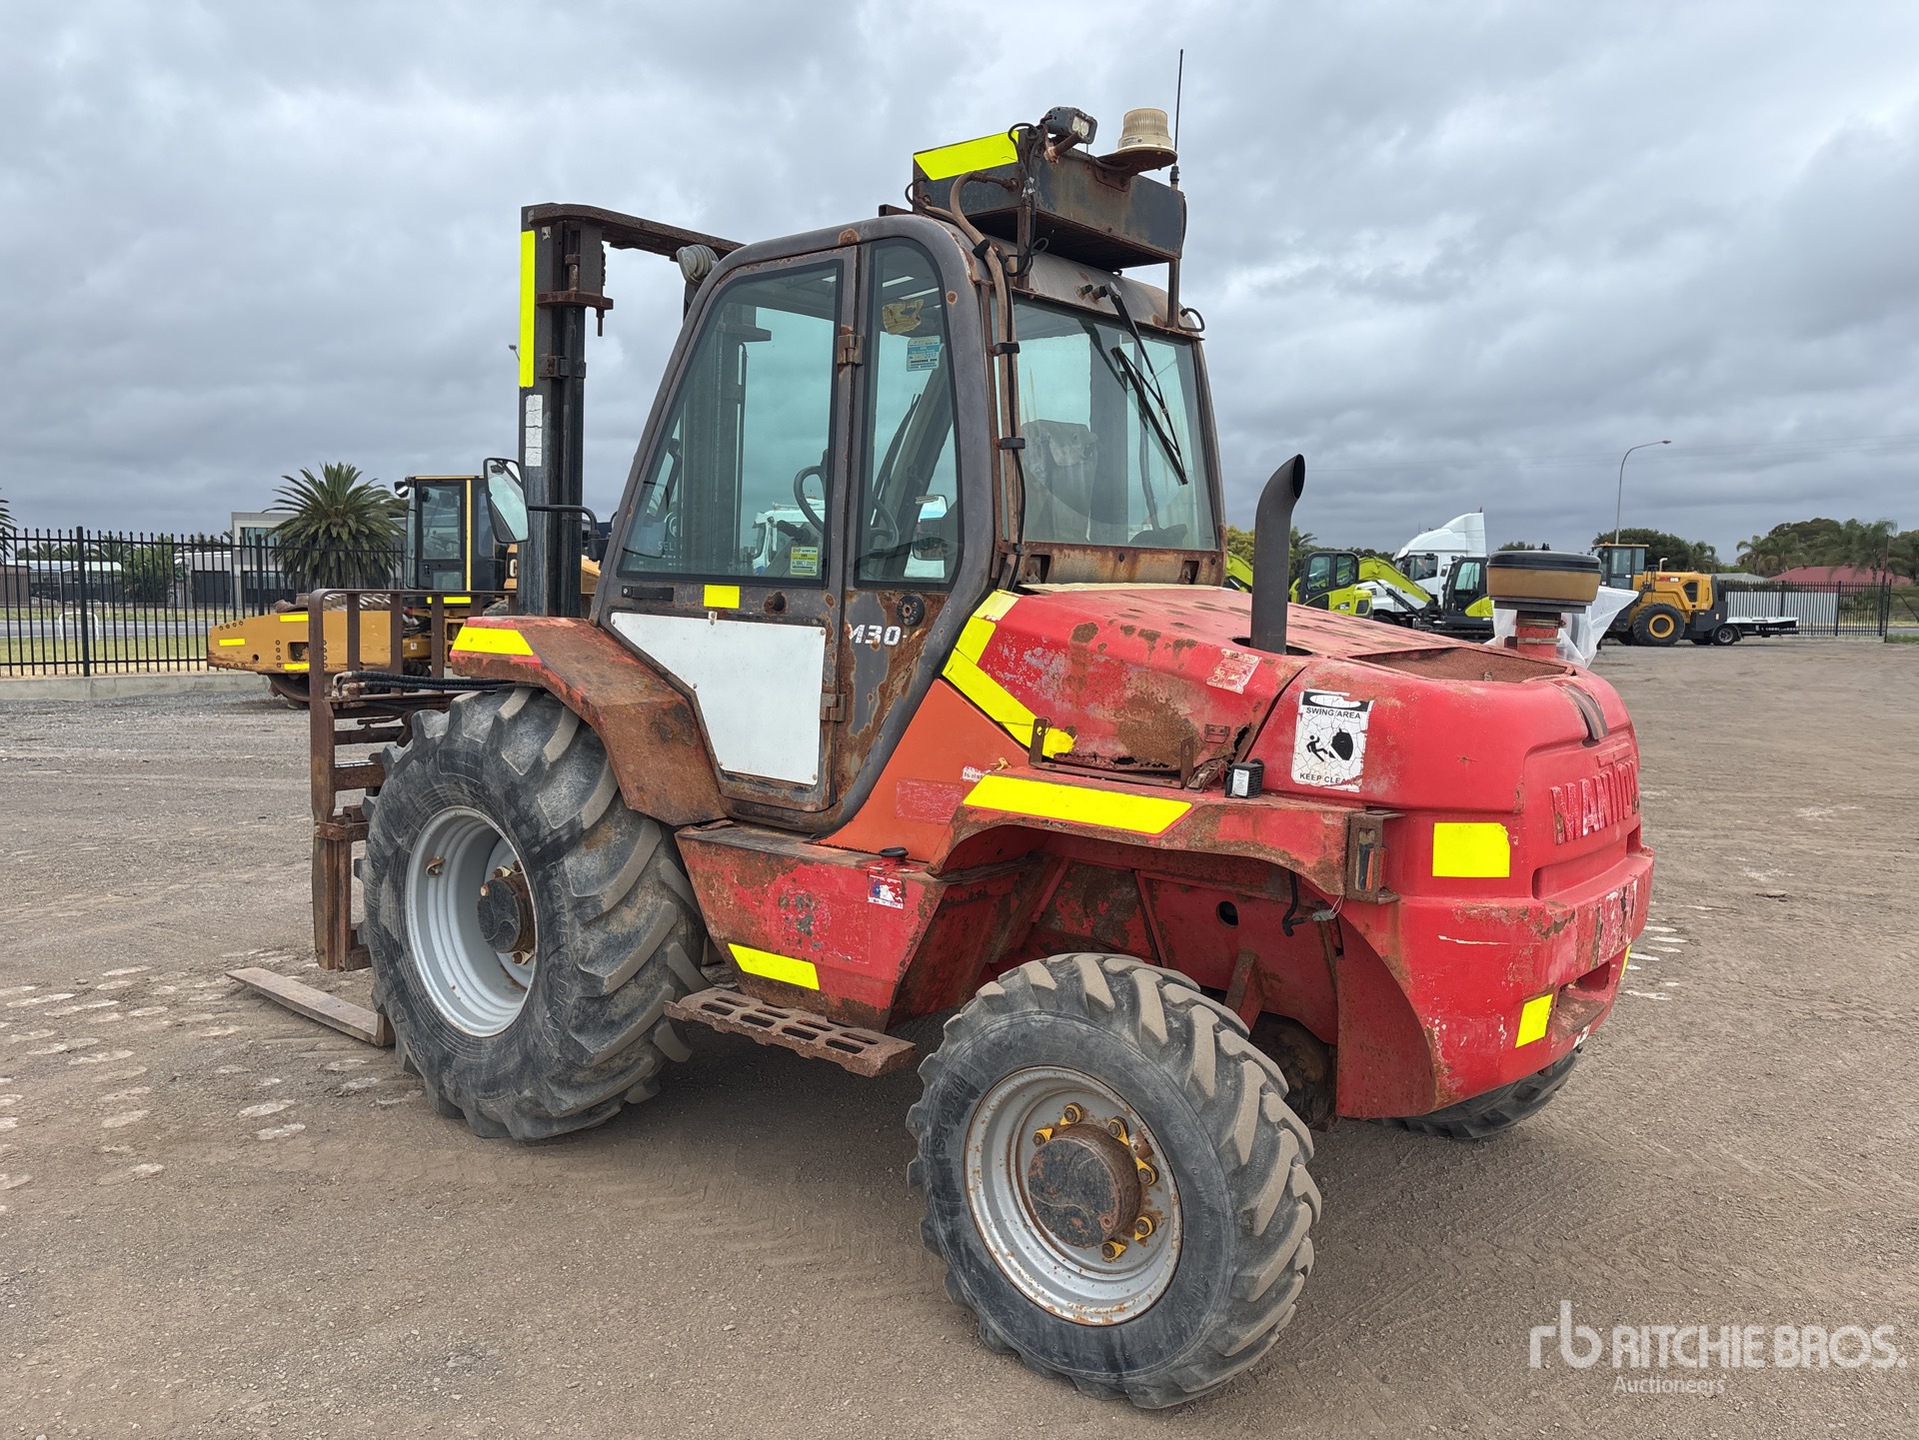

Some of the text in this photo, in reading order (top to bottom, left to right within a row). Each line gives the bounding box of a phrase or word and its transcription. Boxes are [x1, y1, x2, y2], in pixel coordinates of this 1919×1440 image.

[1306, 707, 1361, 720] SWING AREA
[1299, 772, 1351, 785] KEEP CLEA
